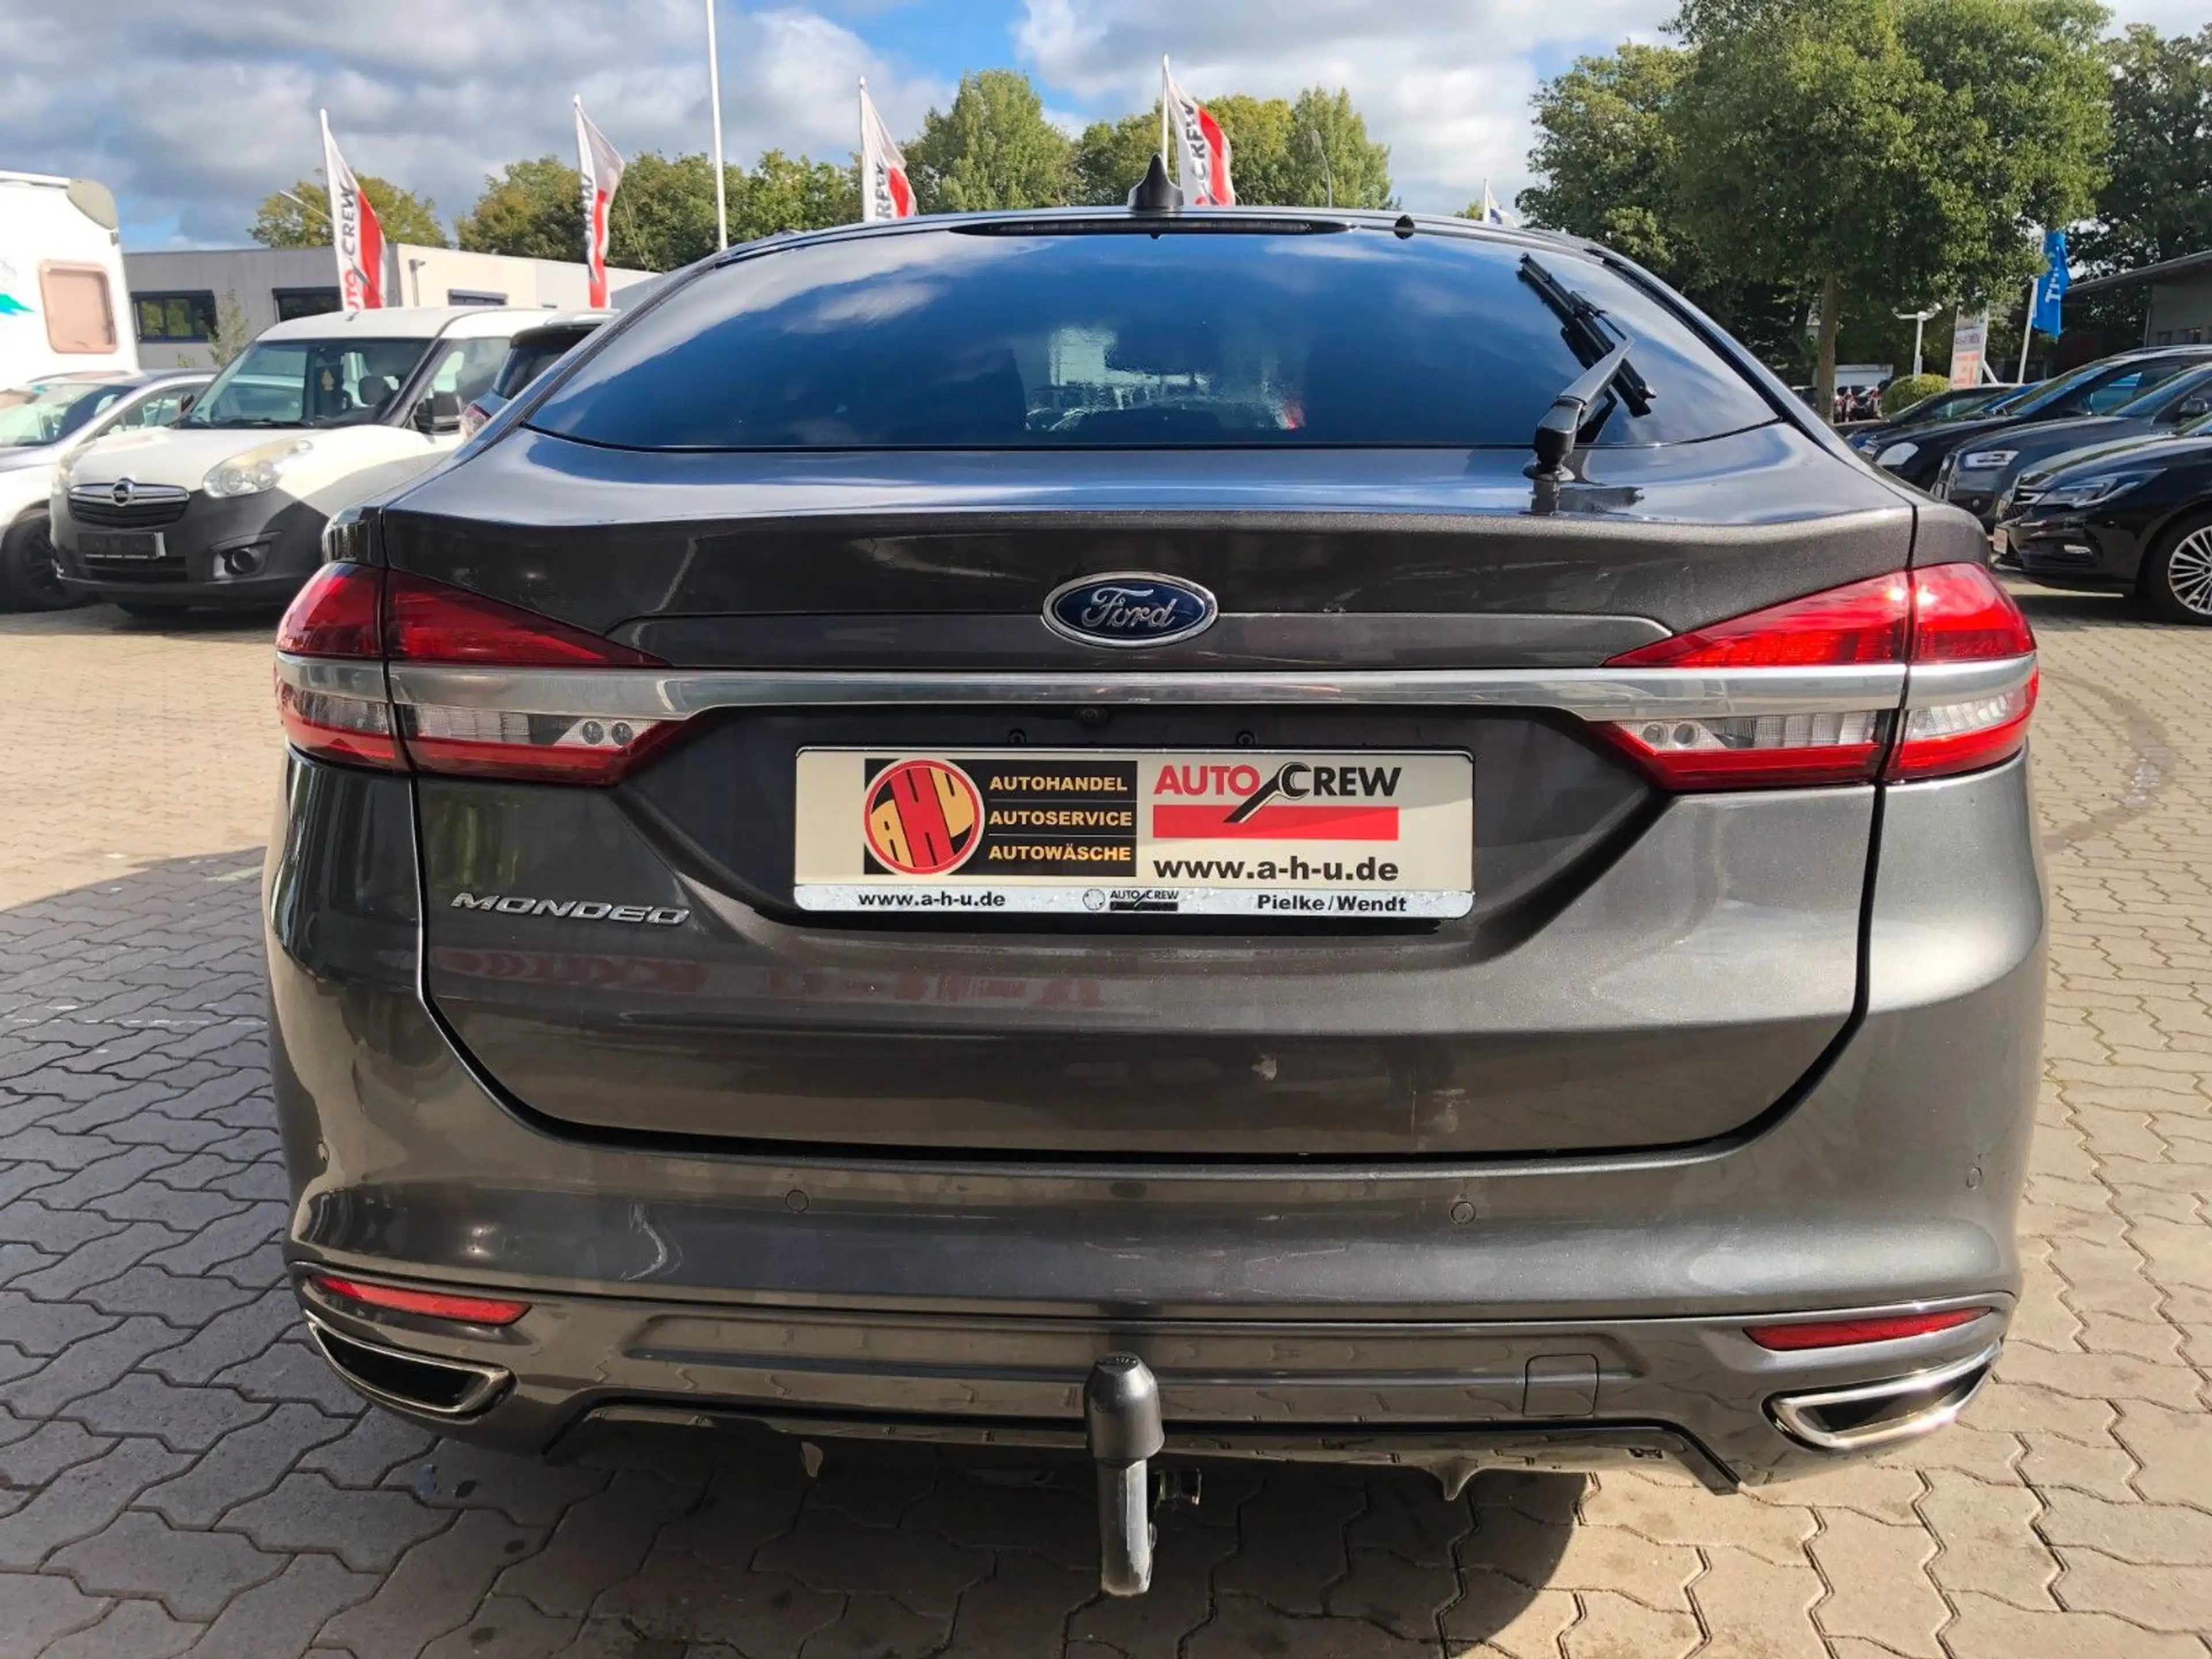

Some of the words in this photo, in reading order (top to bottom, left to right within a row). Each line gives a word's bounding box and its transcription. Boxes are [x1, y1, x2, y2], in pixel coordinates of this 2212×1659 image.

[339, 183, 356, 257] CREW
[1081, 586, 1178, 628] Ford
[989, 775, 1128, 792] AUTOHANDEL
[1153, 764, 1260, 796] AUTO
[1278, 762, 1402, 799] CREW
[988, 810, 1132, 827] AUTOSERVICE
[988, 843, 1131, 861] AUTOWÄSCHE
[1153, 855, 1399, 881] www.a-h-u.de
[858, 891, 1006, 908] www.a-h-u.de
[1109, 890, 1141, 899] AUTO
[1146, 890, 1179, 900] CREW
[1257, 894, 1407, 912] Pielke/Wendt
[450, 892, 690, 925] MONDEO
